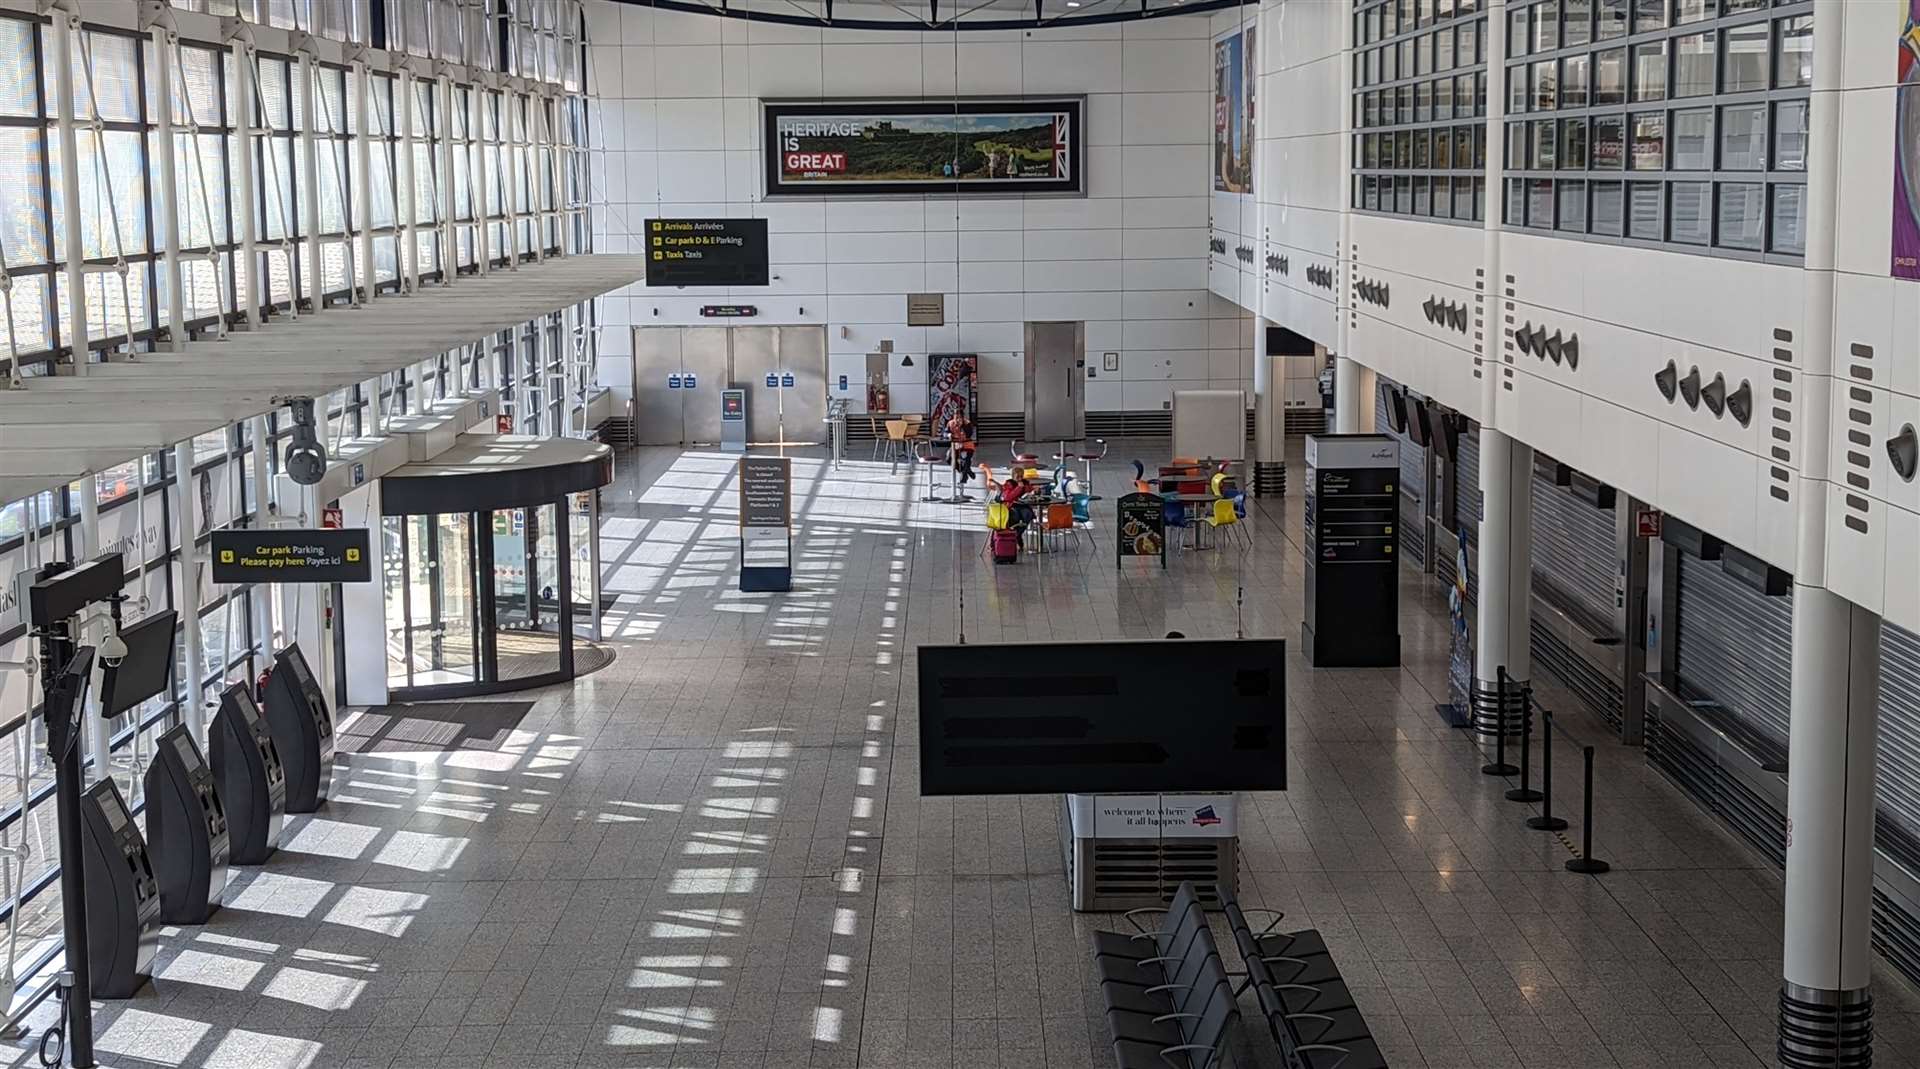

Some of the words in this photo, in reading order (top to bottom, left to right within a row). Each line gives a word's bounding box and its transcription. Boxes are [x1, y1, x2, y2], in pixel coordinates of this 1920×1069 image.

[784, 123, 861, 137] HERITAGE
[784, 137, 800, 152] IS
[787, 154, 844, 169] GREAT
[664, 223, 693, 231] Arrivals
[694, 223, 724, 231] Arrivées
[665, 237, 677, 245] Car
[678, 237, 694, 246] park
[695, 237, 702, 245] D
[702, 237, 710, 245] &
[716, 236, 743, 247] Parking
[666, 251, 684, 259] Taxis
[684, 250, 702, 259] Taxis
[256, 546, 271, 555] Car
[271, 545, 291, 556] park
[292, 545, 324, 556] Parking
[240, 557, 267, 566] Please
[268, 558, 285, 568] pay
[285, 557, 305, 565] here
[306, 556, 330, 568] Payez
[331, 556, 341, 565] ici
[1103, 808, 1145, 816] welcome
[1146, 808, 1155, 816] to
[1157, 807, 1187, 816] where
[1127, 817, 1133, 825] it
[1135, 817, 1146, 825] all
